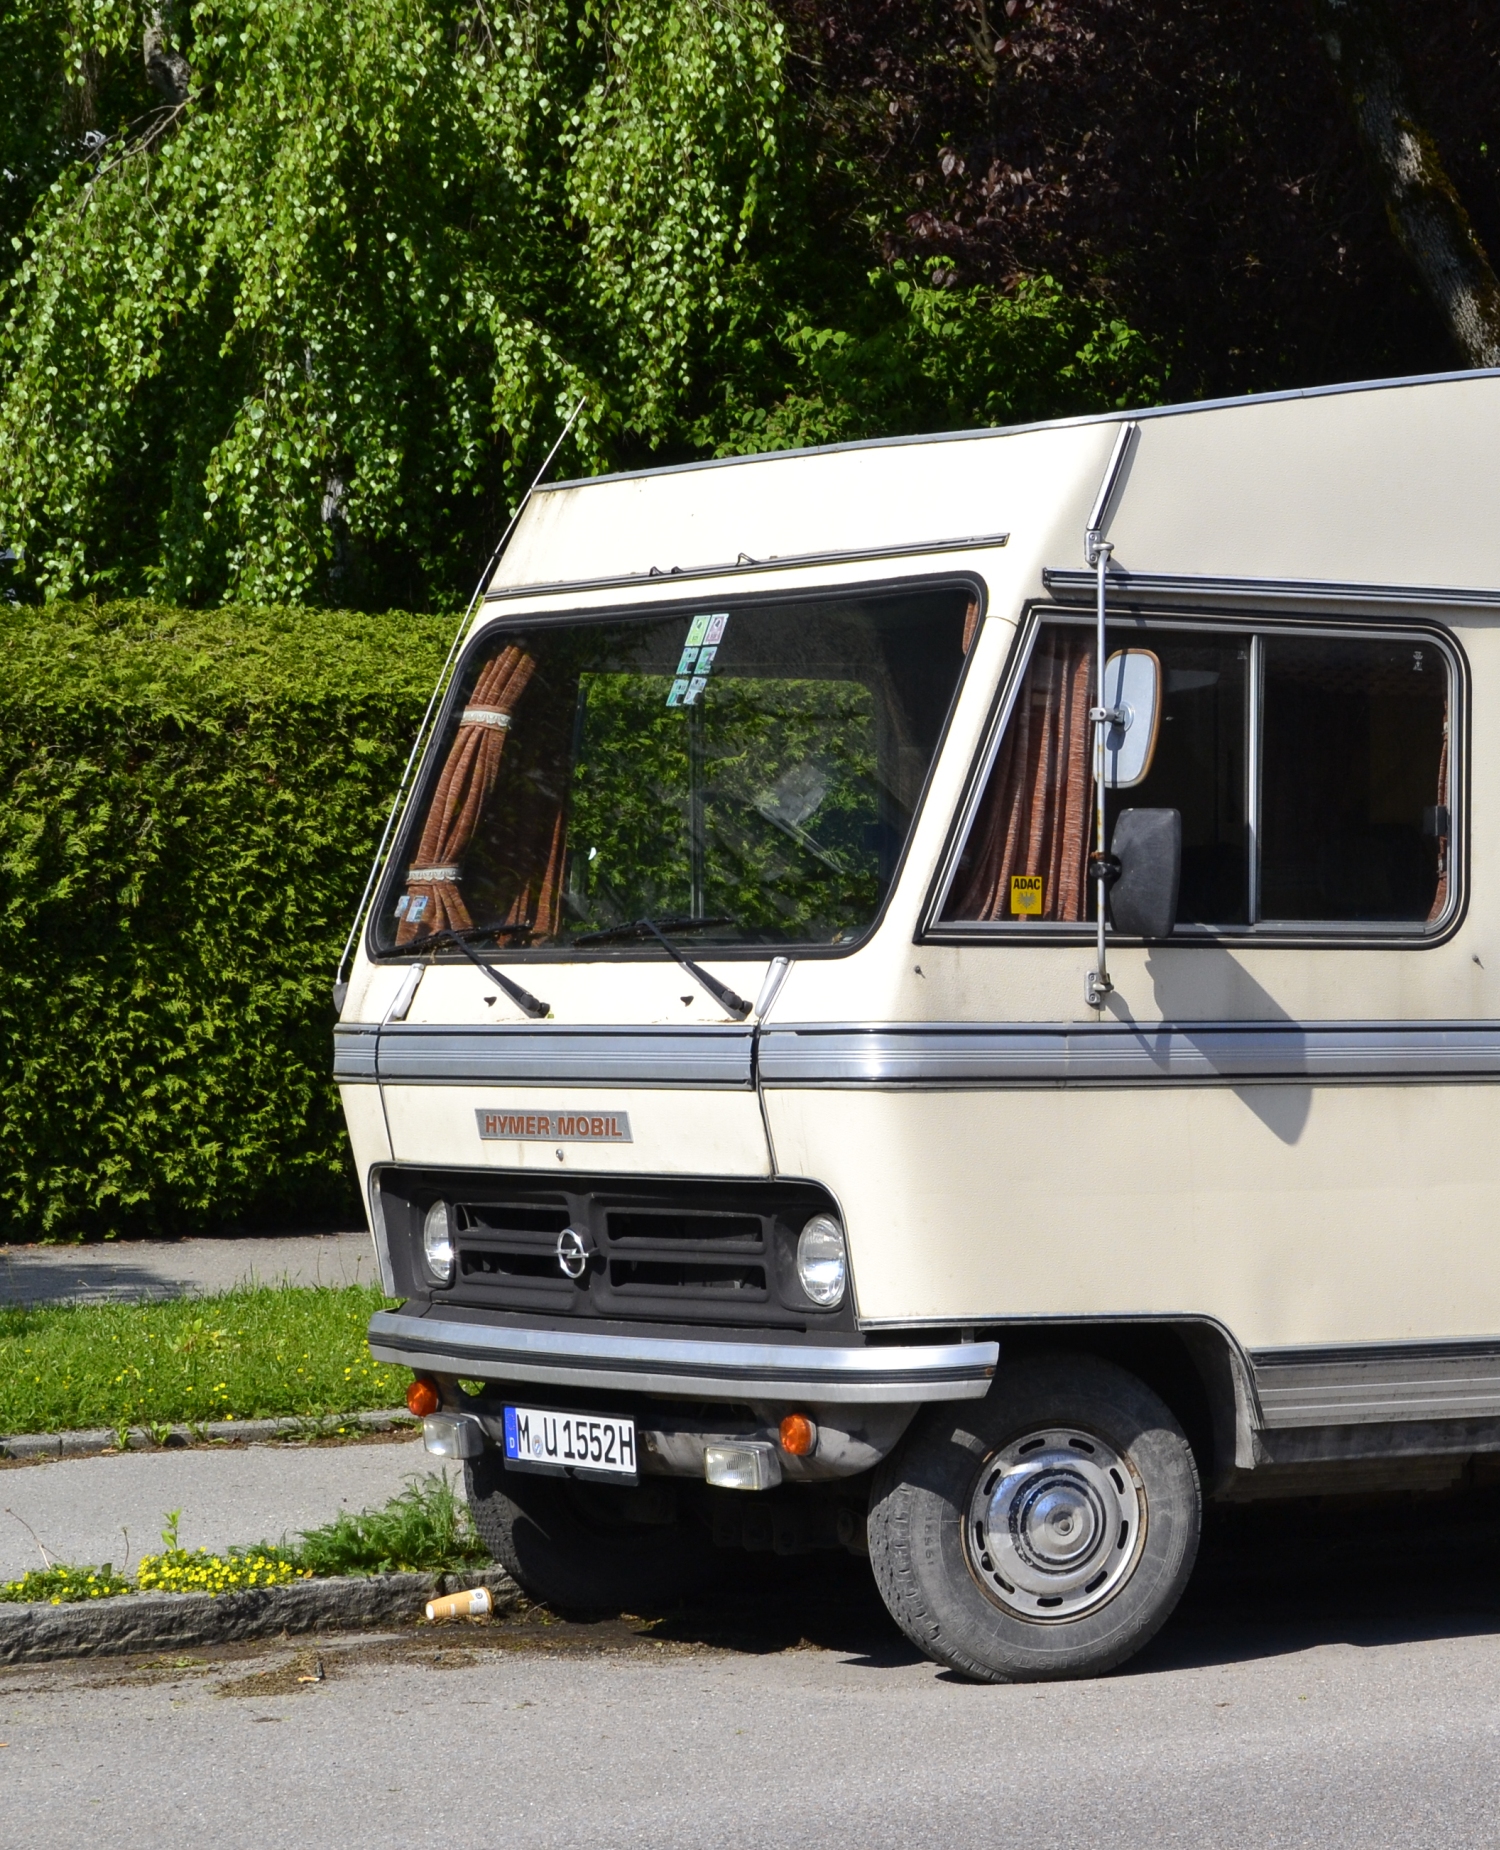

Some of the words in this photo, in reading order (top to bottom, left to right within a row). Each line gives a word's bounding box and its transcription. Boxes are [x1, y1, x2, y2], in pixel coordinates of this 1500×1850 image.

[1013, 877, 1041, 891] ADAC
[485, 1114, 550, 1136] HYMER
[557, 1115, 623, 1138] MOBIL
[509, 1437, 516, 1449] D
